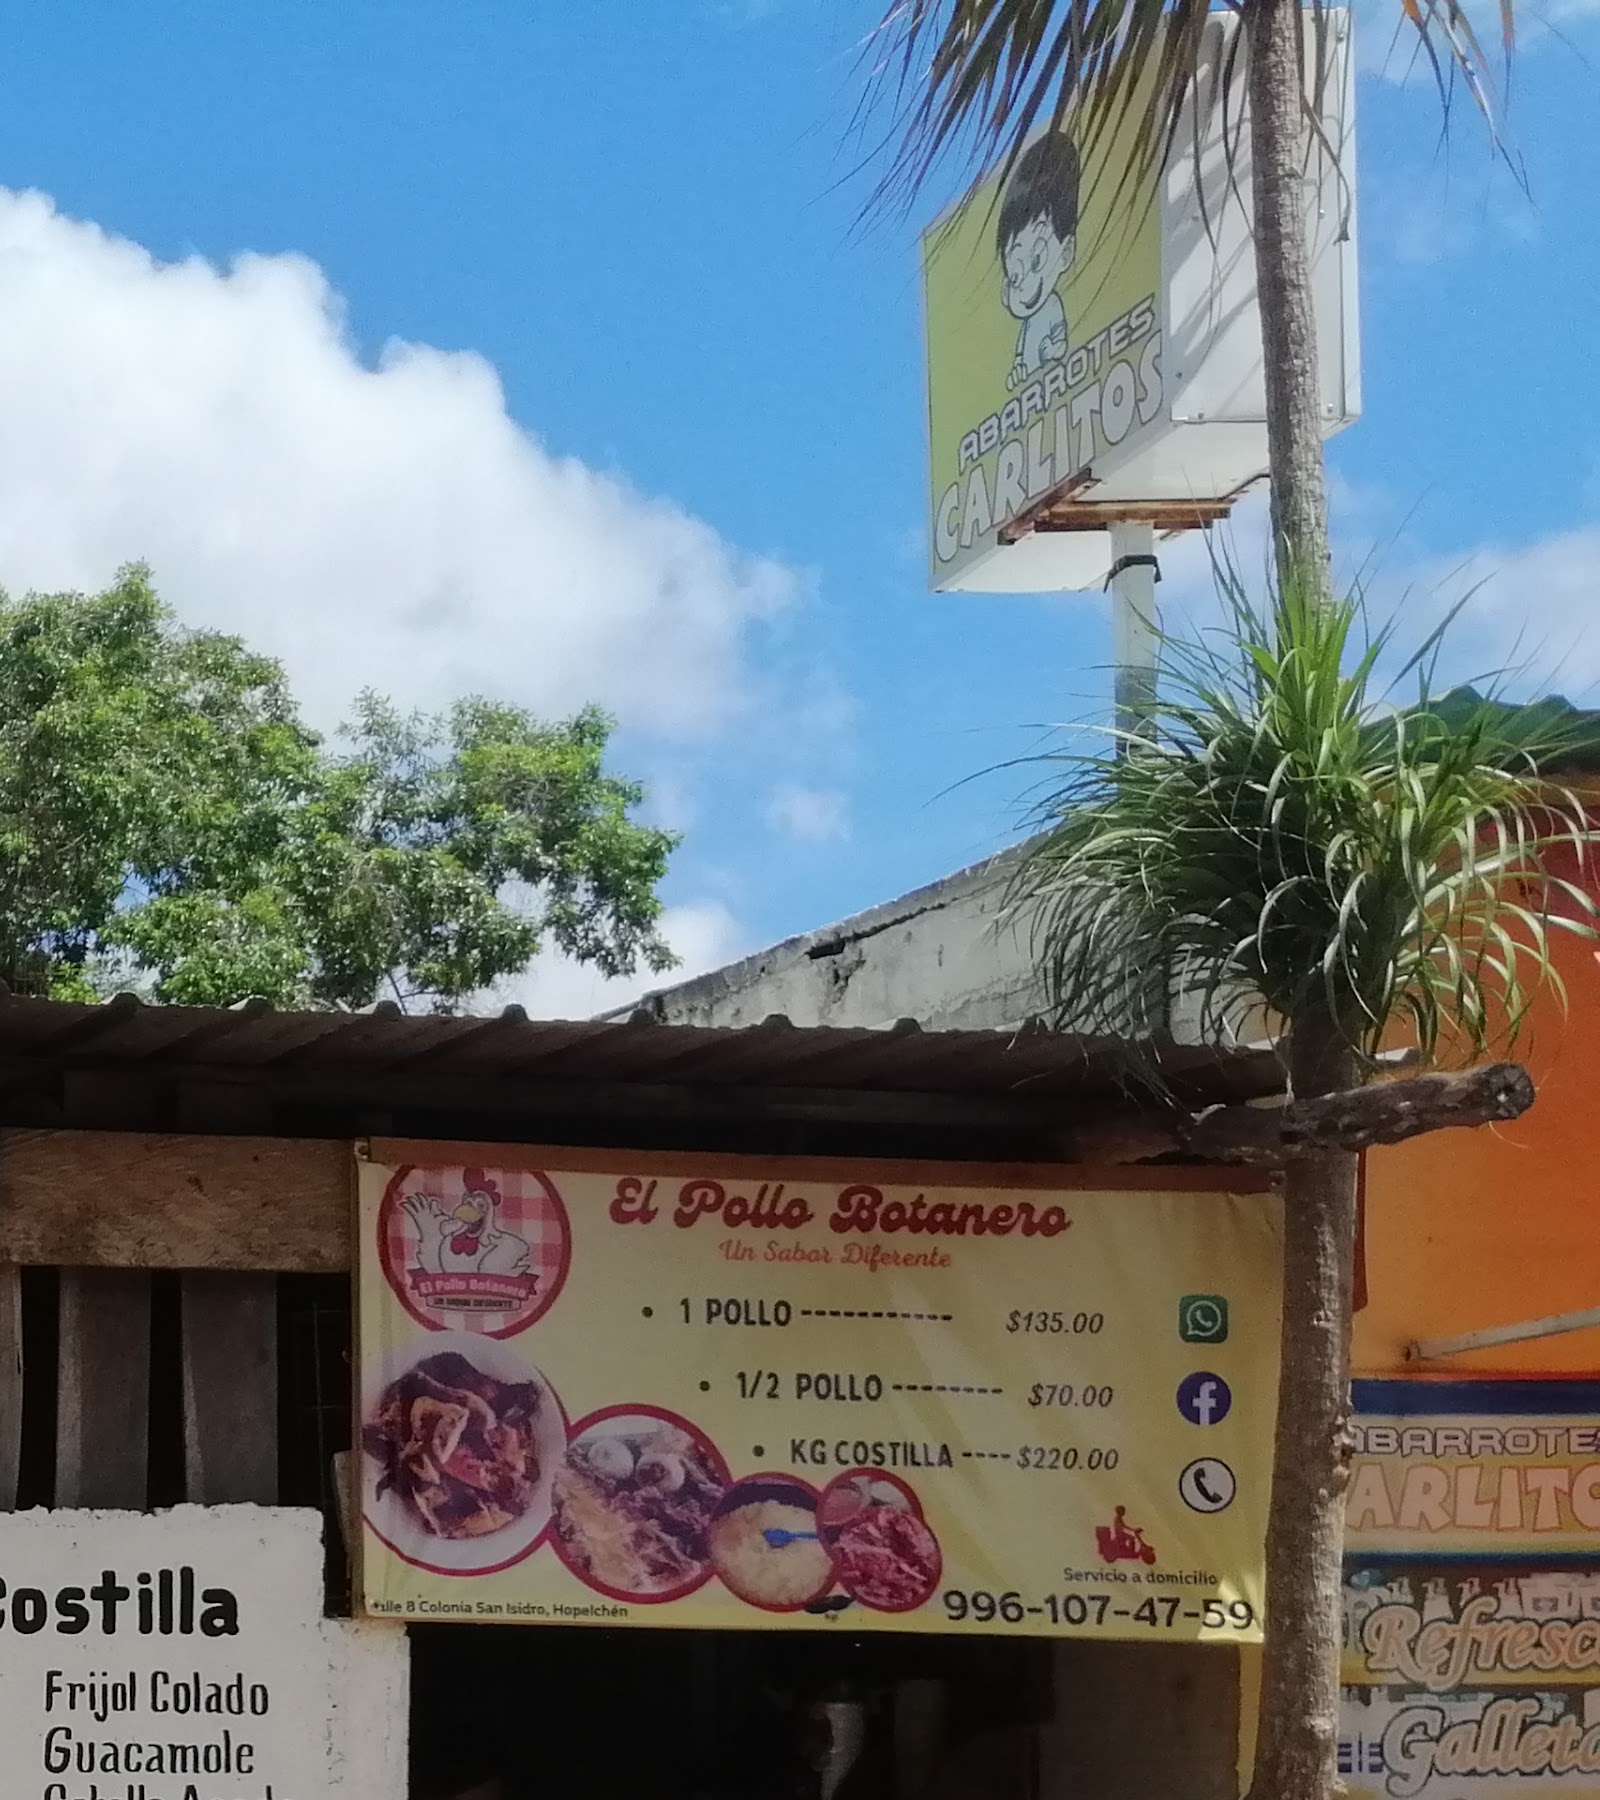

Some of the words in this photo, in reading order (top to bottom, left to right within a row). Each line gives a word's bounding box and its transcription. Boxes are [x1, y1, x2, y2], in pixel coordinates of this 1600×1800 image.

[957, 292, 1156, 475] ABARROTES
[933, 331, 1165, 563] CARLITOS
[609, 1177, 659, 1226] El
[674, 1179, 815, 1229] Pollo
[829, 1184, 1073, 1238] Botanero
[719, 1239, 757, 1263] Un
[763, 1239, 831, 1264] Sabor
[840, 1242, 952, 1273] Diferente
[680, 1298, 691, 1325] 1
[706, 1299, 793, 1327] POLLO
[1006, 1311, 1105, 1335] $135.00
[736, 1371, 781, 1400] 1/2
[796, 1373, 884, 1402] POLLO
[1028, 1382, 1114, 1409] $70.00
[791, 1438, 828, 1466] KG
[834, 1439, 954, 1468] COSTILLA
[1016, 1447, 1120, 1472] $220.00
[1351, 1426, 1600, 1458] BARROTE
[1063, 1567, 1128, 1584] Servicio
[1131, 1571, 1143, 1584] a
[1146, 1569, 1218, 1586] domicilio
[419, 1601, 473, 1615] Colonia
[476, 1602, 503, 1615] San
[553, 1605, 629, 1619] Hopelchén
[942, 1590, 1254, 1630] 996-107-47-59
[1360, 1596, 1600, 1692] Refresc
[46, 1670, 137, 1723] Frijol
[151, 1671, 270, 1716] Colado
[44, 1727, 255, 1774] Guacamole
